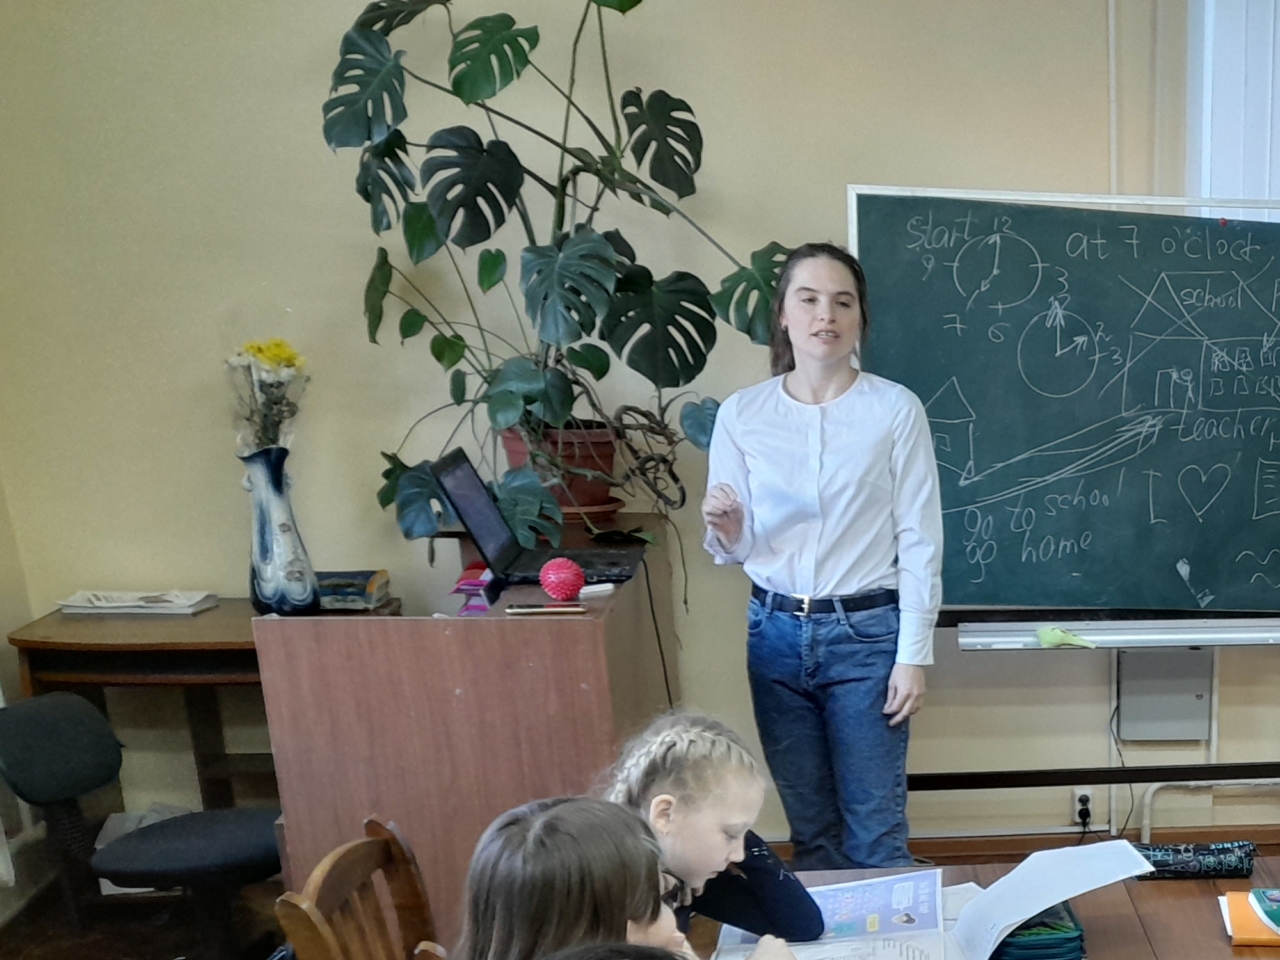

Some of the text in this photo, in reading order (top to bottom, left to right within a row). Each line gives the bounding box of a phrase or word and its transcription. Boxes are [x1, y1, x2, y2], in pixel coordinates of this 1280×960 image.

[906, 208, 978, 251] Start
[1065, 228, 1110, 260] at
[1117, 225, 1141, 259] 7
[1180, 278, 1243, 309] school
[943, 313, 968, 336] 7
[987, 322, 1011, 343] 6
[1170, 412, 1270, 442] teacher
[962, 466, 1126, 545] go to school
[1021, 529, 1093, 563] home
